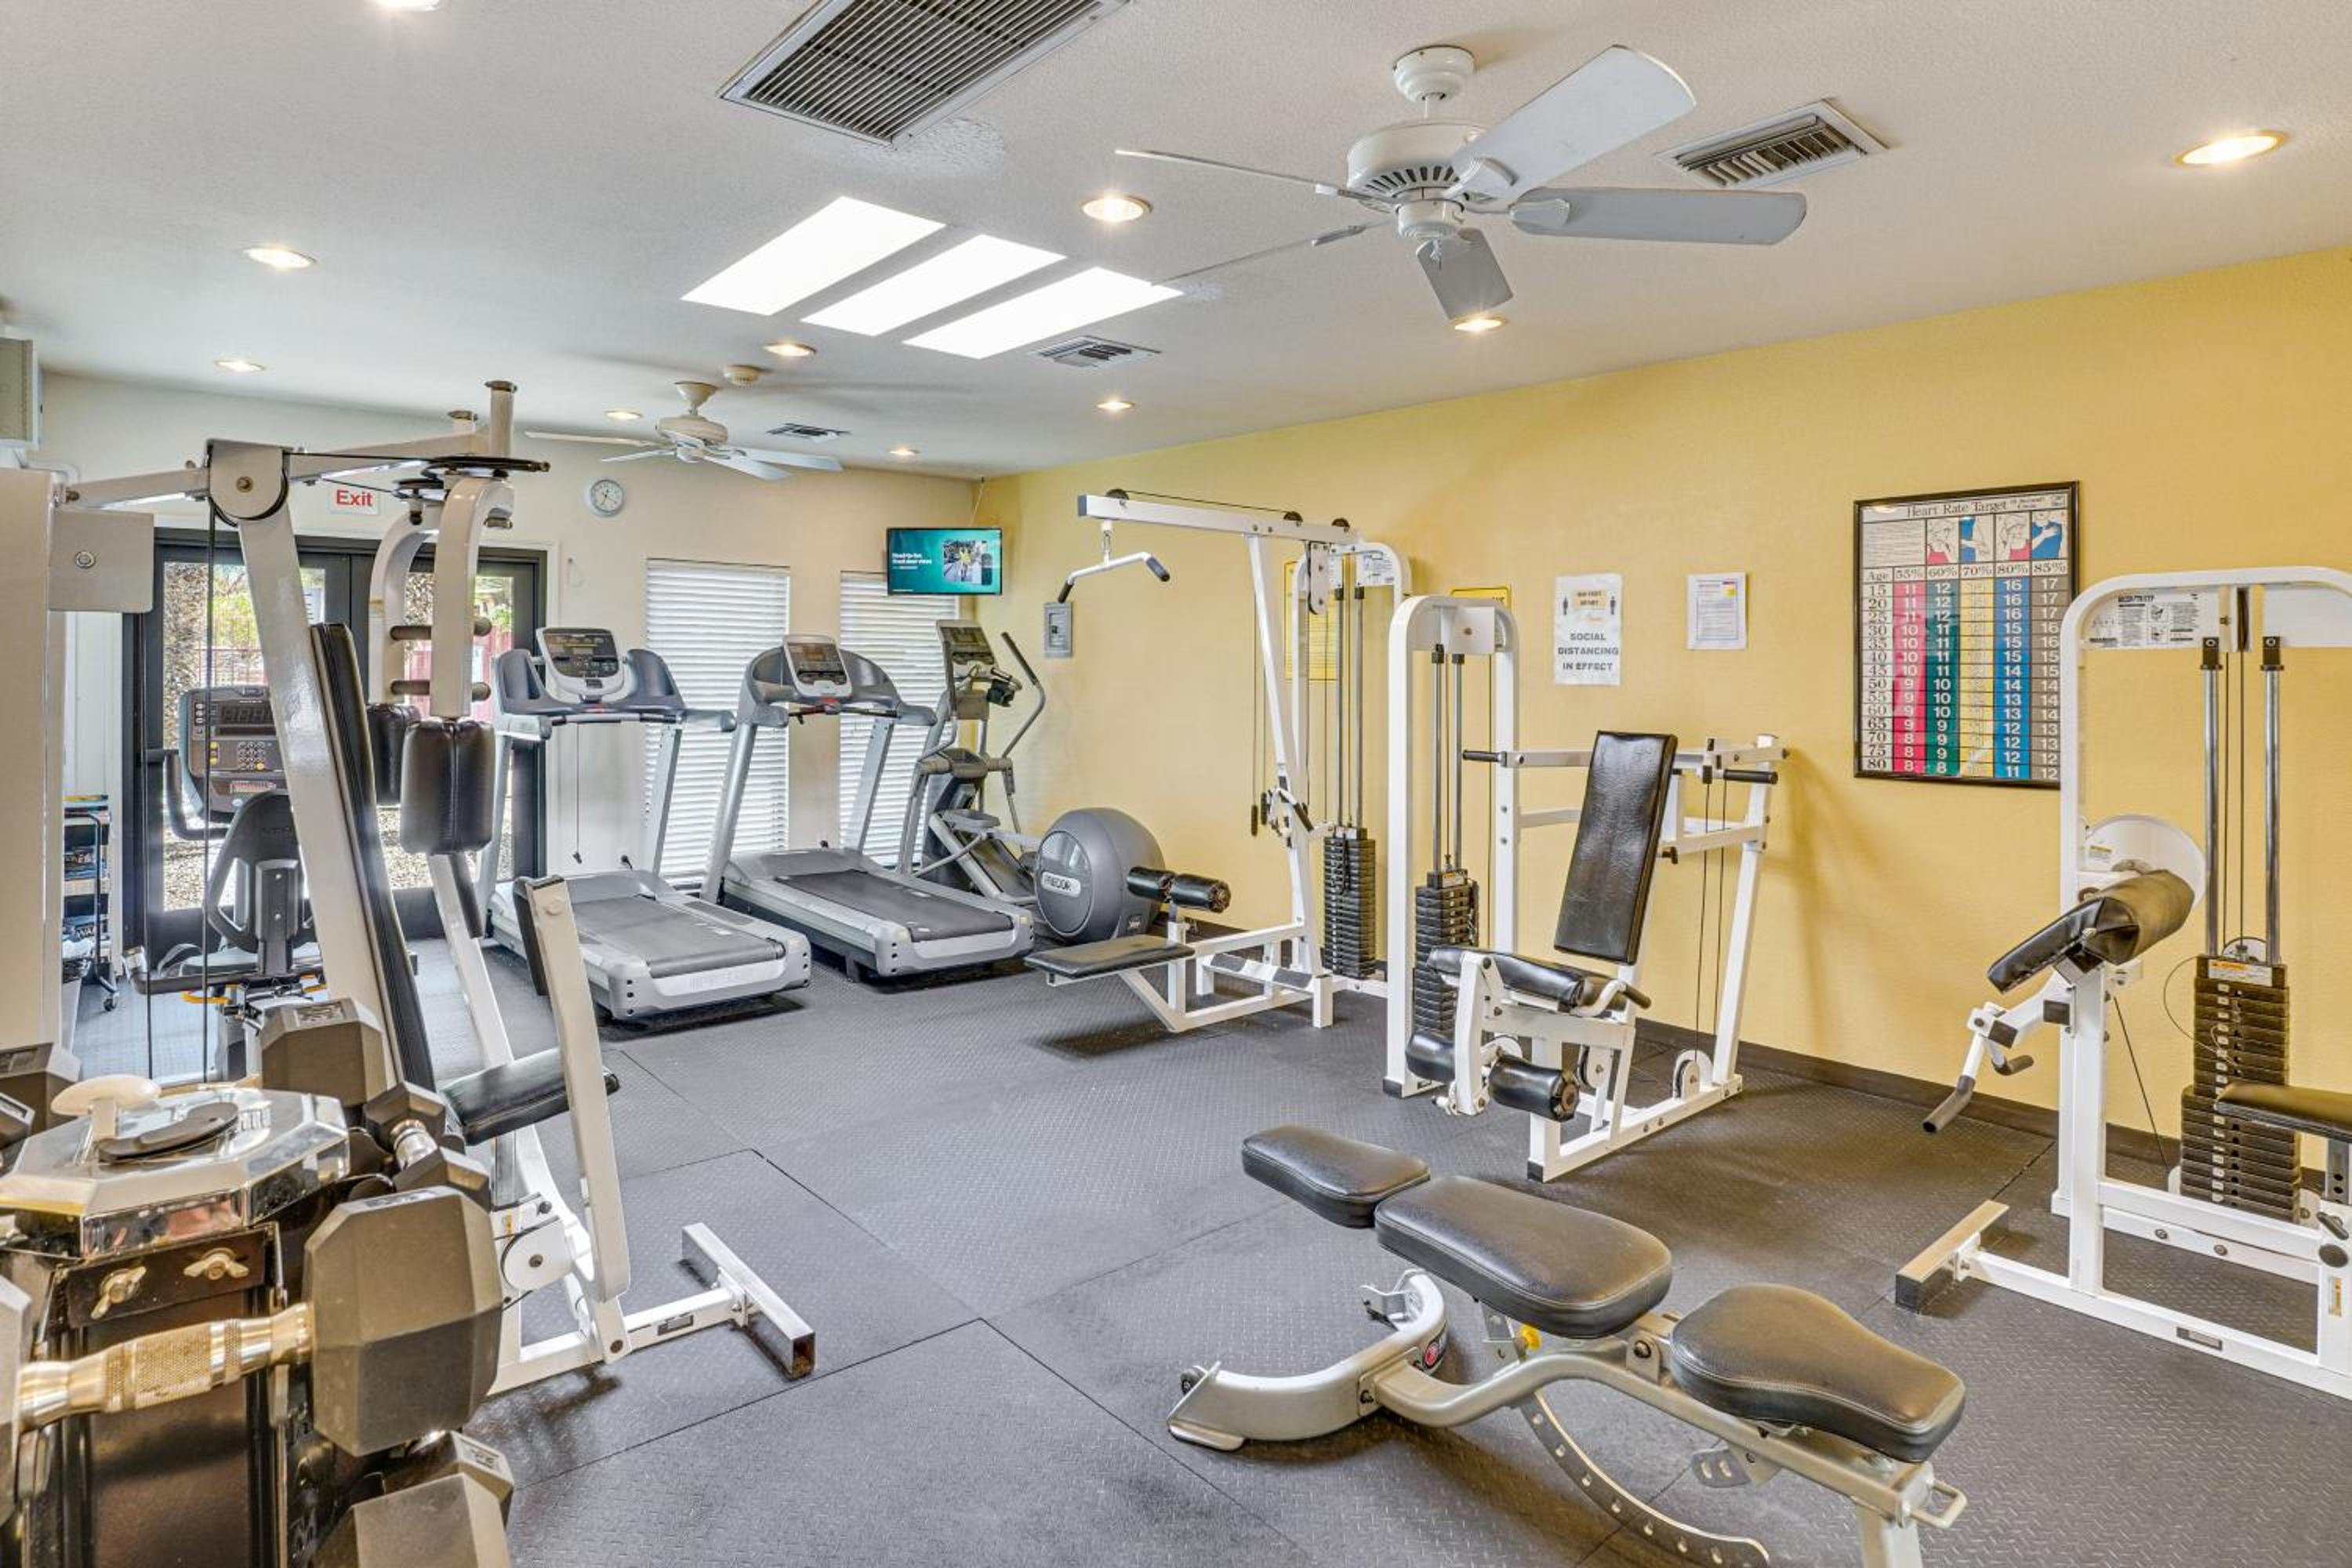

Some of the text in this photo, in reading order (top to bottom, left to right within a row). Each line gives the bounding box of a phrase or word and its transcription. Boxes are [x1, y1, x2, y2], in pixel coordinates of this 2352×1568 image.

[337, 490, 372, 506] Exit
[1907, 506, 1938, 518] Heart
[1944, 504, 1969, 515] Rate
[1973, 500, 2006, 514] Target
[1928, 567, 1958, 577] 60%
[1963, 565, 1993, 576] 70%
[1997, 564, 2029, 574] 80%
[2033, 562, 2066, 572] 85%
[1906, 585, 1916, 593] 11
[1936, 583, 1951, 593] 12
[2004, 580, 2021, 590] 16
[2042, 579, 2058, 589] 17
[1868, 593, 2058, 609] 20 11 12 16 17
[1906, 612, 1916, 622] 11
[1936, 611, 1951, 621] 12
[2004, 608, 2021, 619] 16
[2042, 607, 2058, 618] 17
[1903, 626, 1918, 635] 10
[1936, 624, 1949, 633] 11
[2004, 622, 2021, 633] 15
[2042, 622, 2058, 633] 16
[1570, 633, 1606, 641] SOCIAL
[1903, 639, 1918, 648] 10
[1936, 638, 1949, 648] 11
[2004, 637, 2021, 648] 15
[2042, 636, 2058, 647] 16
[1558, 647, 1619, 655] DISTANCING
[1903, 652, 1918, 662] 10
[1936, 652, 1949, 661] 11
[2004, 652, 2021, 662] 15
[2042, 651, 2058, 662] 15
[1576, 662, 1613, 671] EFFECT
[1903, 666, 1918, 674] 10
[1936, 666, 1949, 675] 11
[2004, 666, 2021, 676] 14
[2042, 666, 2058, 676] 15
[1868, 679, 2058, 691] 50 9 10 14 14
[1905, 693, 1914, 702] 9
[1934, 693, 1951, 703] 10
[2004, 694, 2021, 704] 13
[2042, 695, 2058, 706] 14
[1905, 706, 1914, 716] 9
[1934, 707, 1951, 717] 10
[2004, 708, 2021, 719] 13
[2042, 710, 2058, 720] 14
[1905, 720, 1914, 730] 9
[1937, 721, 1947, 731] 9
[2004, 722, 2021, 733] 12
[2042, 724, 2058, 735] 13
[1868, 731, 2058, 750] 70 8 9 12 13
[1905, 747, 1914, 757] 8
[1937, 748, 1947, 758] 9
[2004, 751, 2021, 762] 12
[2042, 753, 2058, 764] 12
[1868, 758, 2058, 780] 80 8 8 11 12
